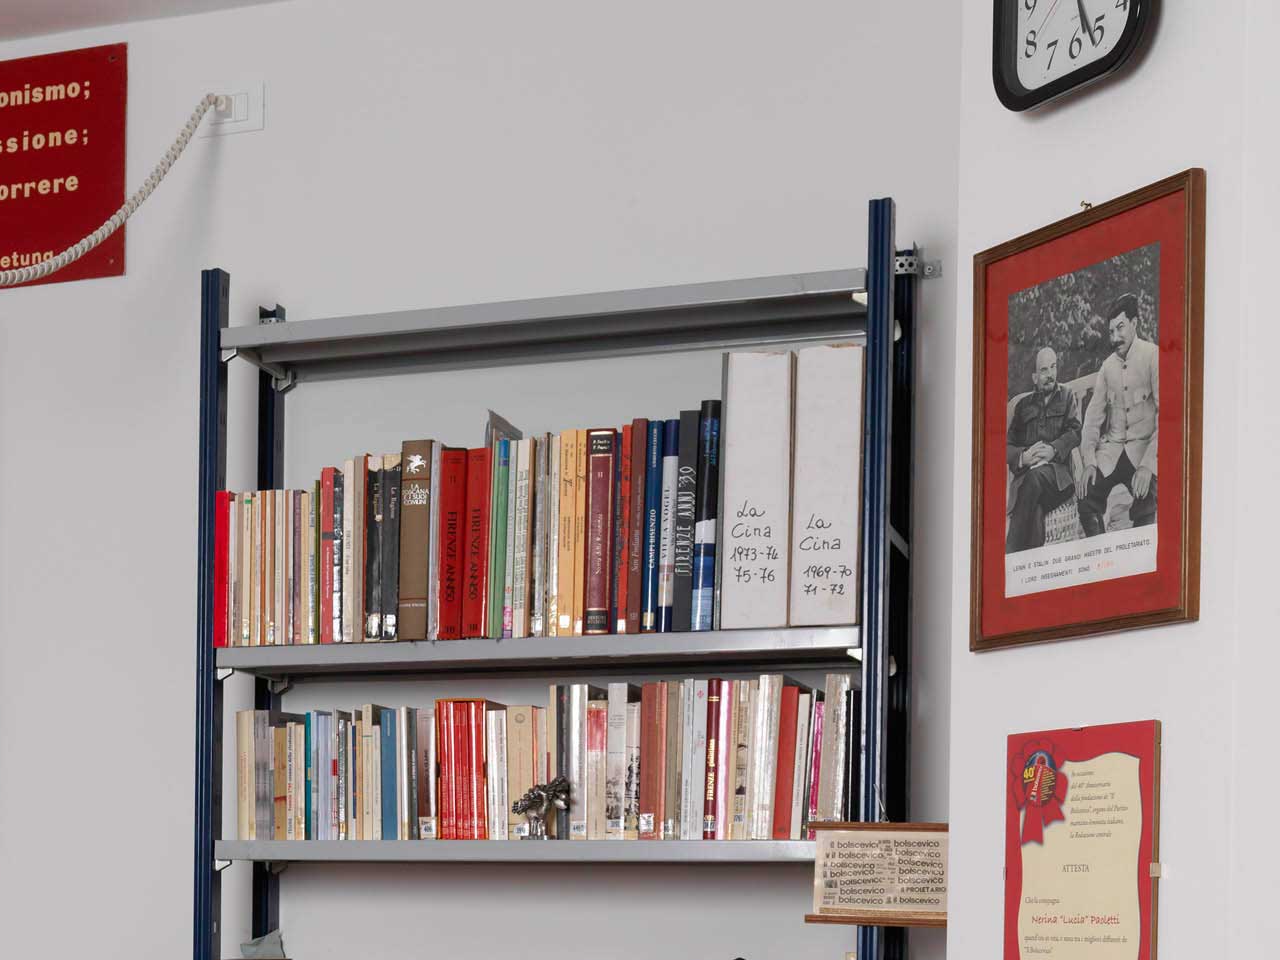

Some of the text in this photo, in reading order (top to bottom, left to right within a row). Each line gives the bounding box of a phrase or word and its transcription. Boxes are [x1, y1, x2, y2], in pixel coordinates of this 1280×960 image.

[1092, 14, 1105, 48] 5
[1024, 30, 1037, 58] 8
[1068, 26, 1082, 59] 6
[1046, 39, 1059, 71] 7
[391, 487, 397, 495] La
[678, 491, 696, 521] ANNI
[737, 500, 765, 518] La
[806, 514, 831, 530] La
[447, 512, 458, 560] FIRENZE
[472, 508, 481, 557] FIRENZE
[731, 523, 771, 539] Cina
[675, 524, 695, 577] FIRENZE
[799, 536, 841, 551] Cina
[649, 544, 657, 569] CAMPI
[1033, 560, 1049, 568] STALIN
[1052, 557, 1062, 565] DUE
[894, 840, 939, 848] bolscevico
[830, 861, 875, 869] bolscevico
[898, 858, 943, 869] bolscevico
[1062, 864, 1090, 872] ATTESTA
[830, 869, 875, 878] bolscevico
[897, 876, 944, 884] bolscevico
[840, 887, 885, 895] bolscevico
[838, 896, 883, 905] bolscevico
[899, 896, 940, 905] bolscevico
[1031, 913, 1120, 925] Nerina "Lucia" Paoletti
